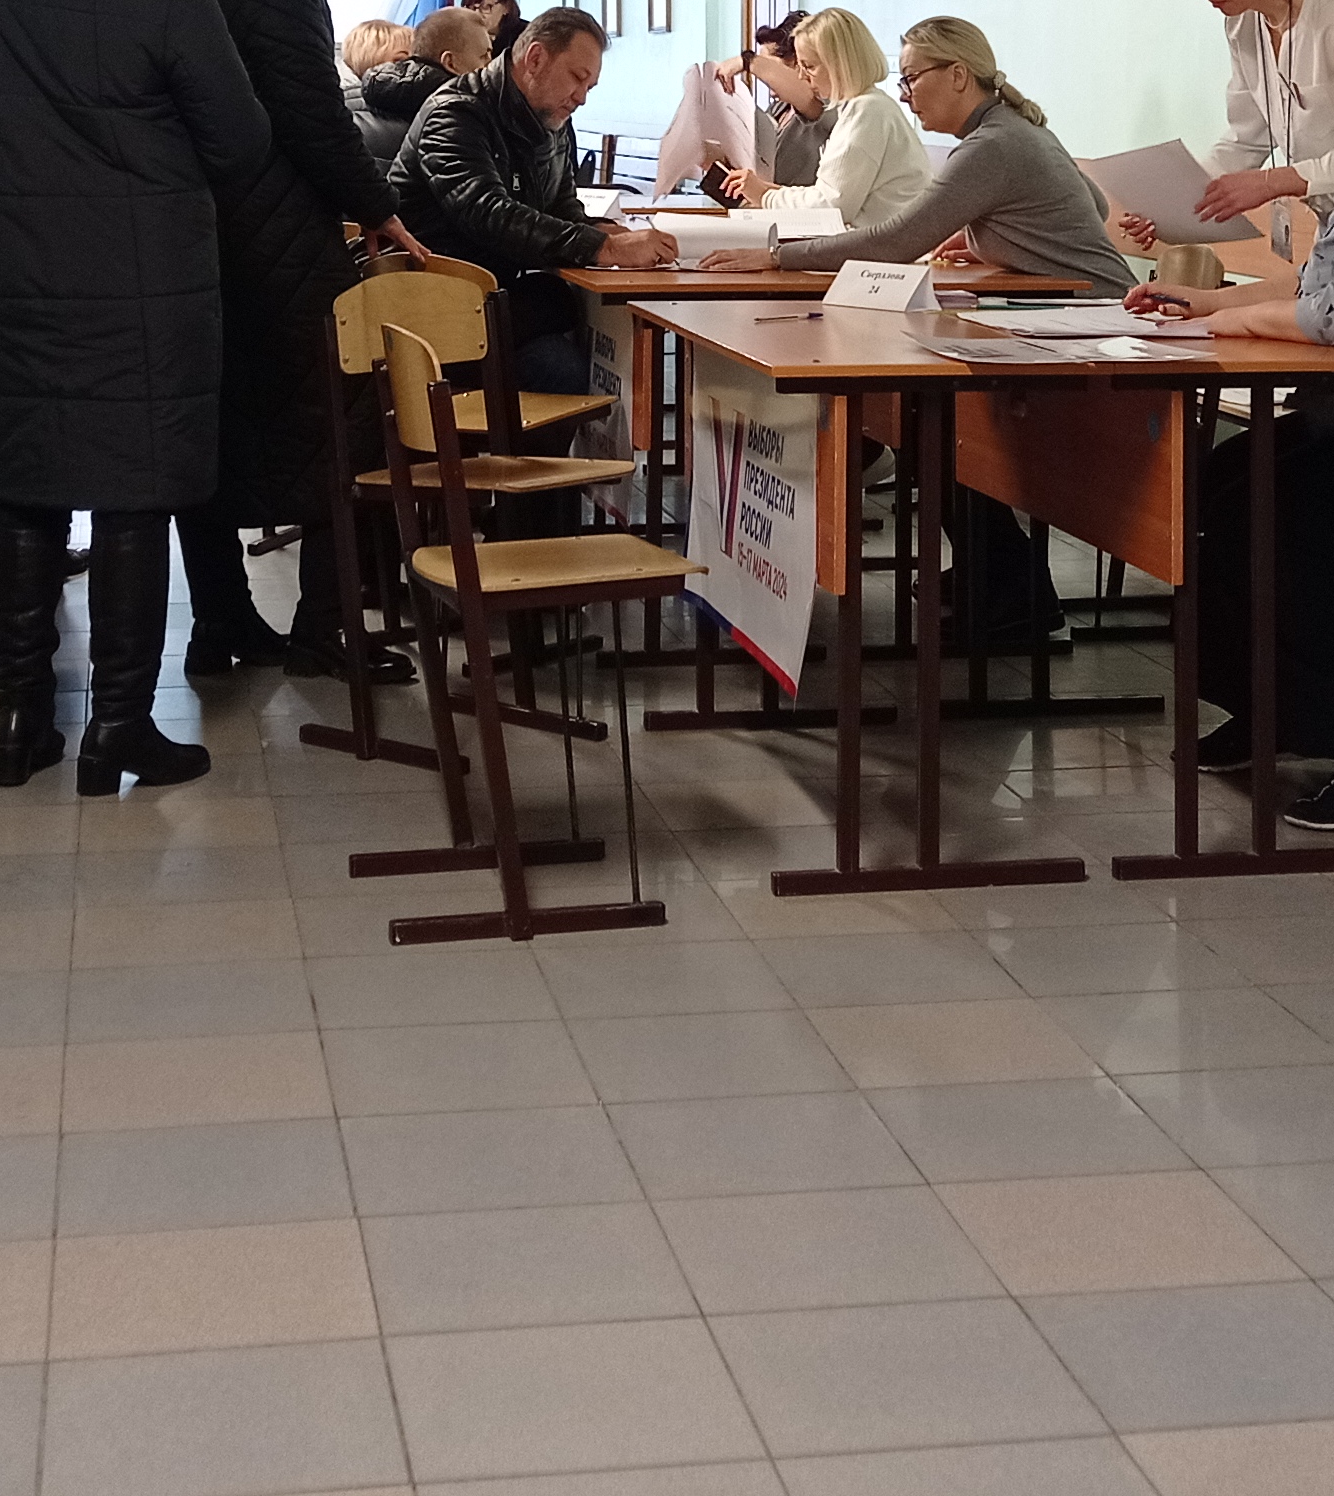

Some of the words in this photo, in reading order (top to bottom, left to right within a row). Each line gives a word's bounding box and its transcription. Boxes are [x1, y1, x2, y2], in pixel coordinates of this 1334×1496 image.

[860, 269, 906, 281] Свердлова
[747, 418, 785, 466] ВЫБОРЫ
[744, 460, 796, 520] ПРЕЗИДЕНТА
[739, 501, 773, 550] РОССИИ
[752, 551, 773, 591] МАРТА
[772, 567, 788, 603] 2024
